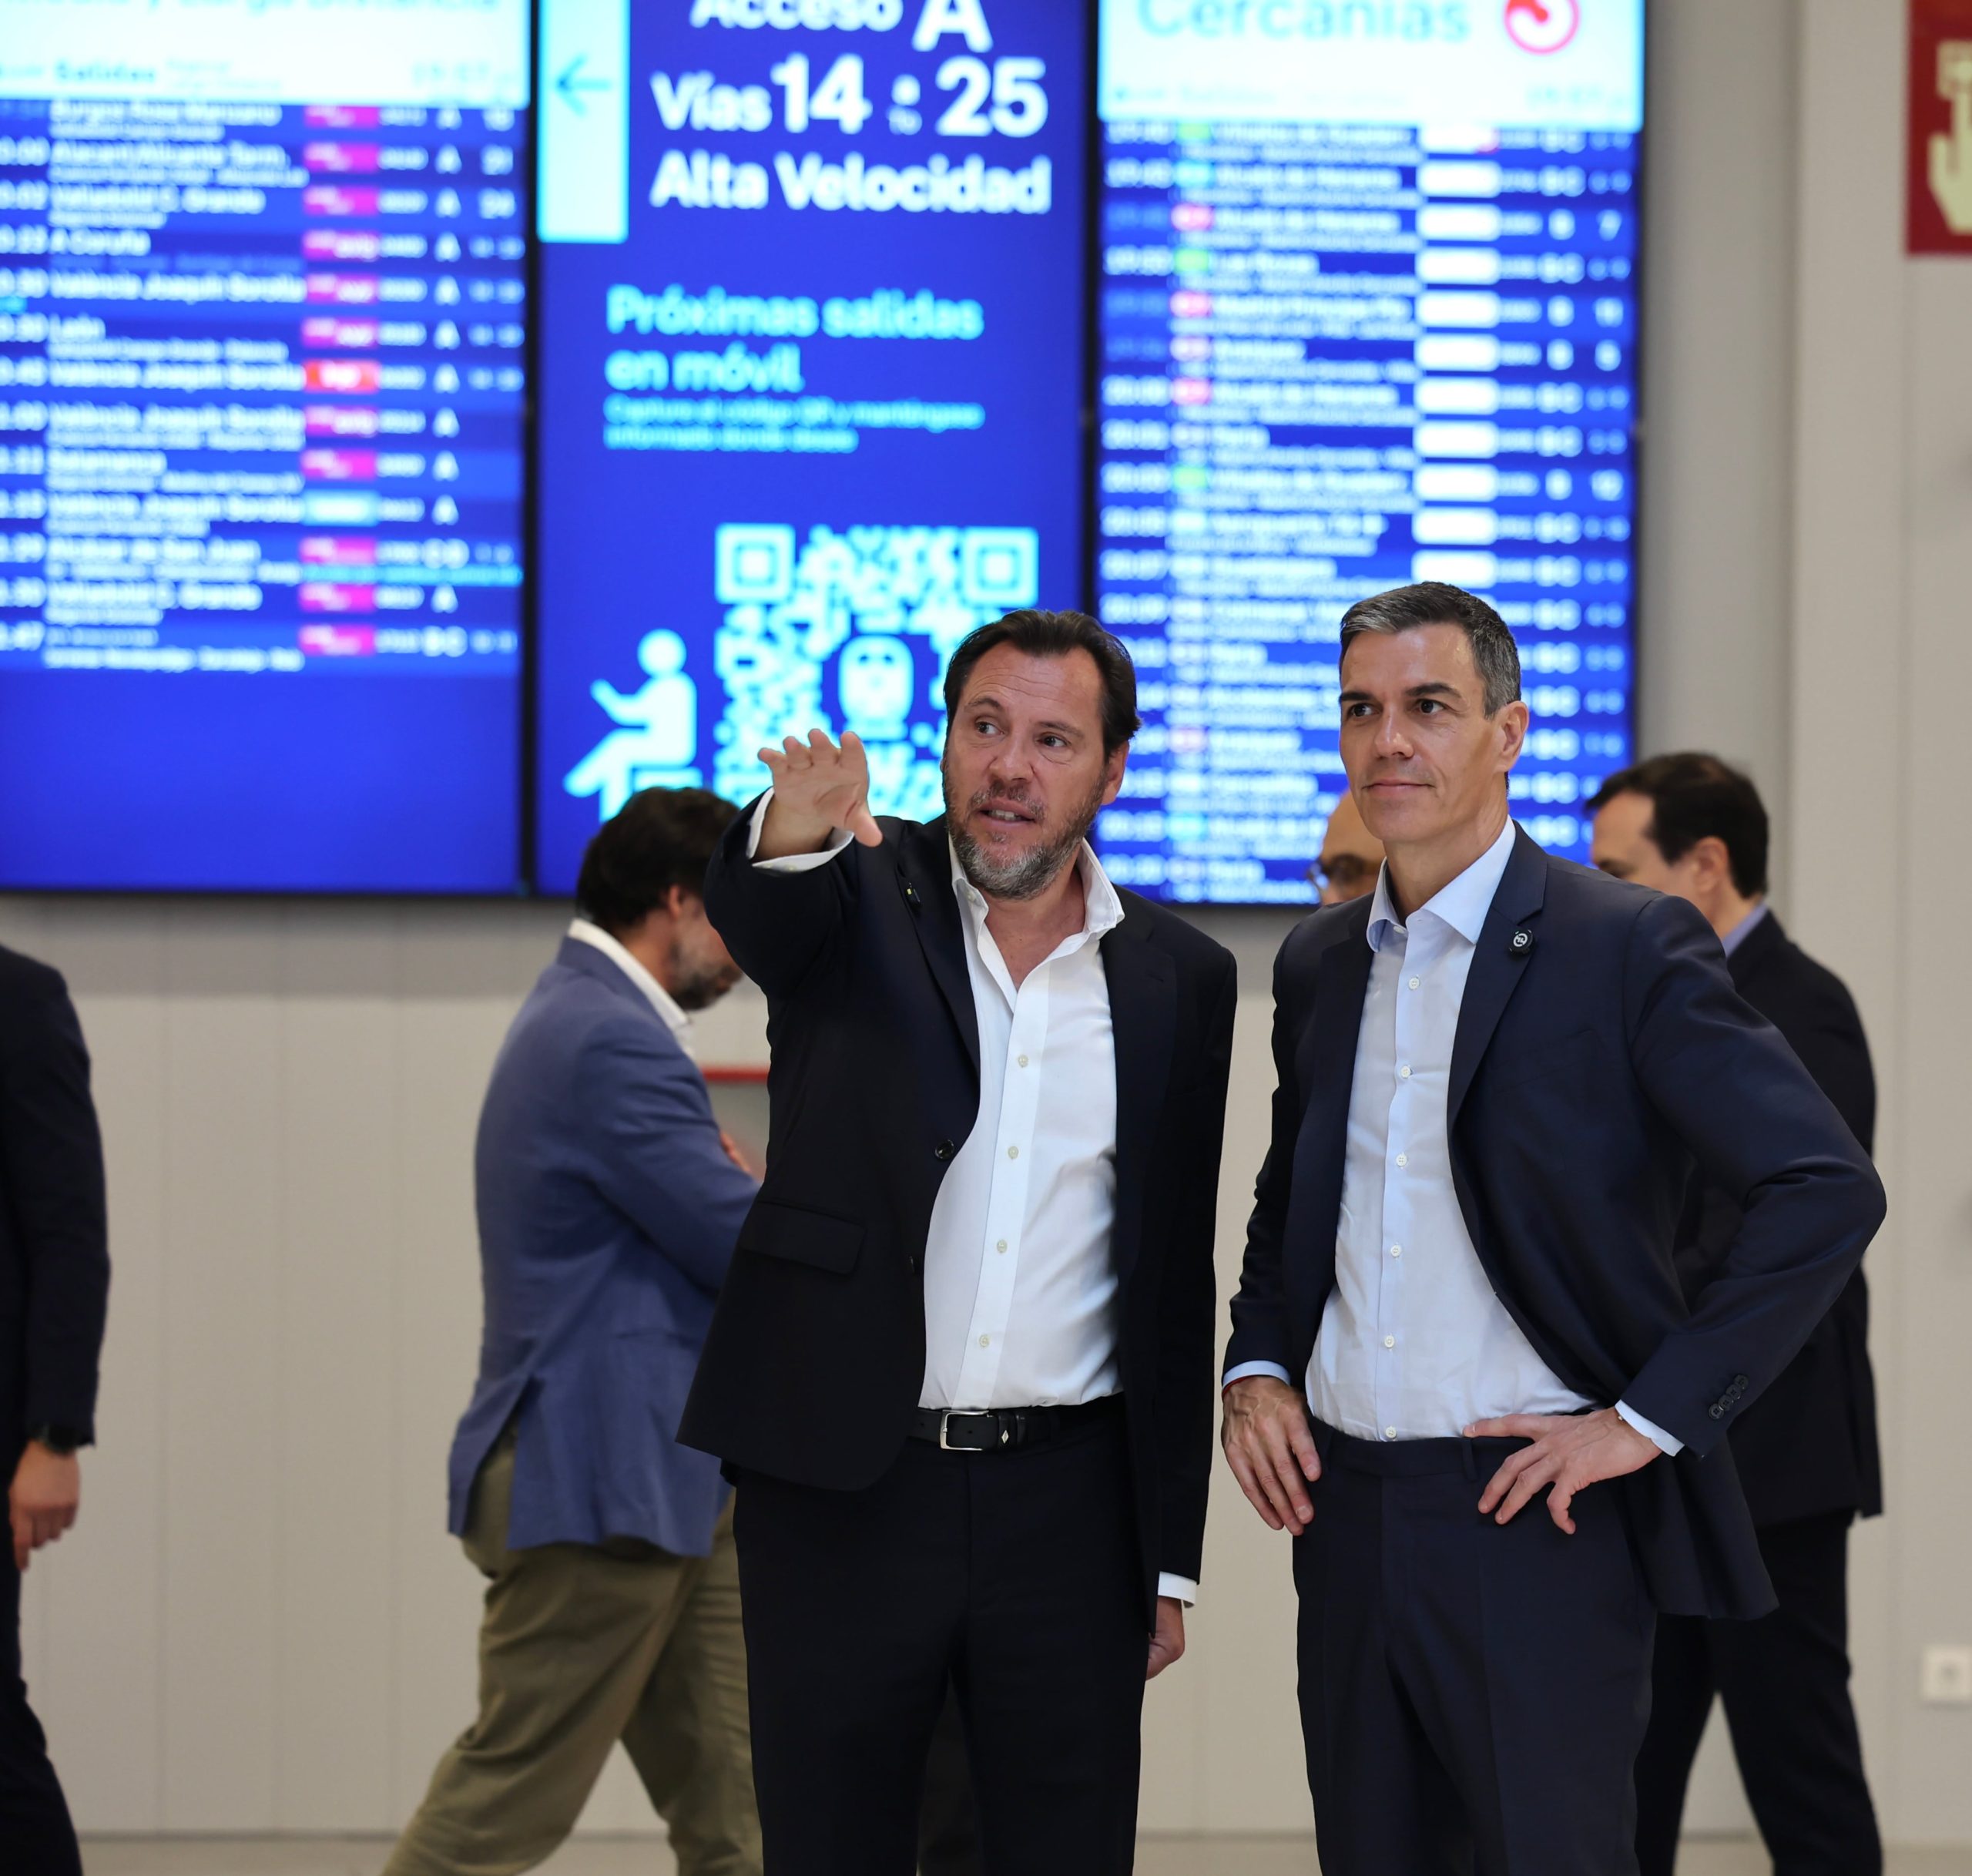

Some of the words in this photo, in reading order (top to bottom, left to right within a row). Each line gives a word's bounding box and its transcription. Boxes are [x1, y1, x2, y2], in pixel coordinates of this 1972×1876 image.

[911, 0, 993, 52] A
[649, 70, 772, 131] Vías
[770, 52, 873, 134] 14
[935, 55, 1048, 137] 25
[649, 149, 769, 209] Alta
[774, 152, 1051, 214] Velocidad
[606, 283, 820, 337] Próximas
[820, 288, 984, 339] salidas
[605, 349, 669, 391] en
[672, 341, 805, 392] móvil
